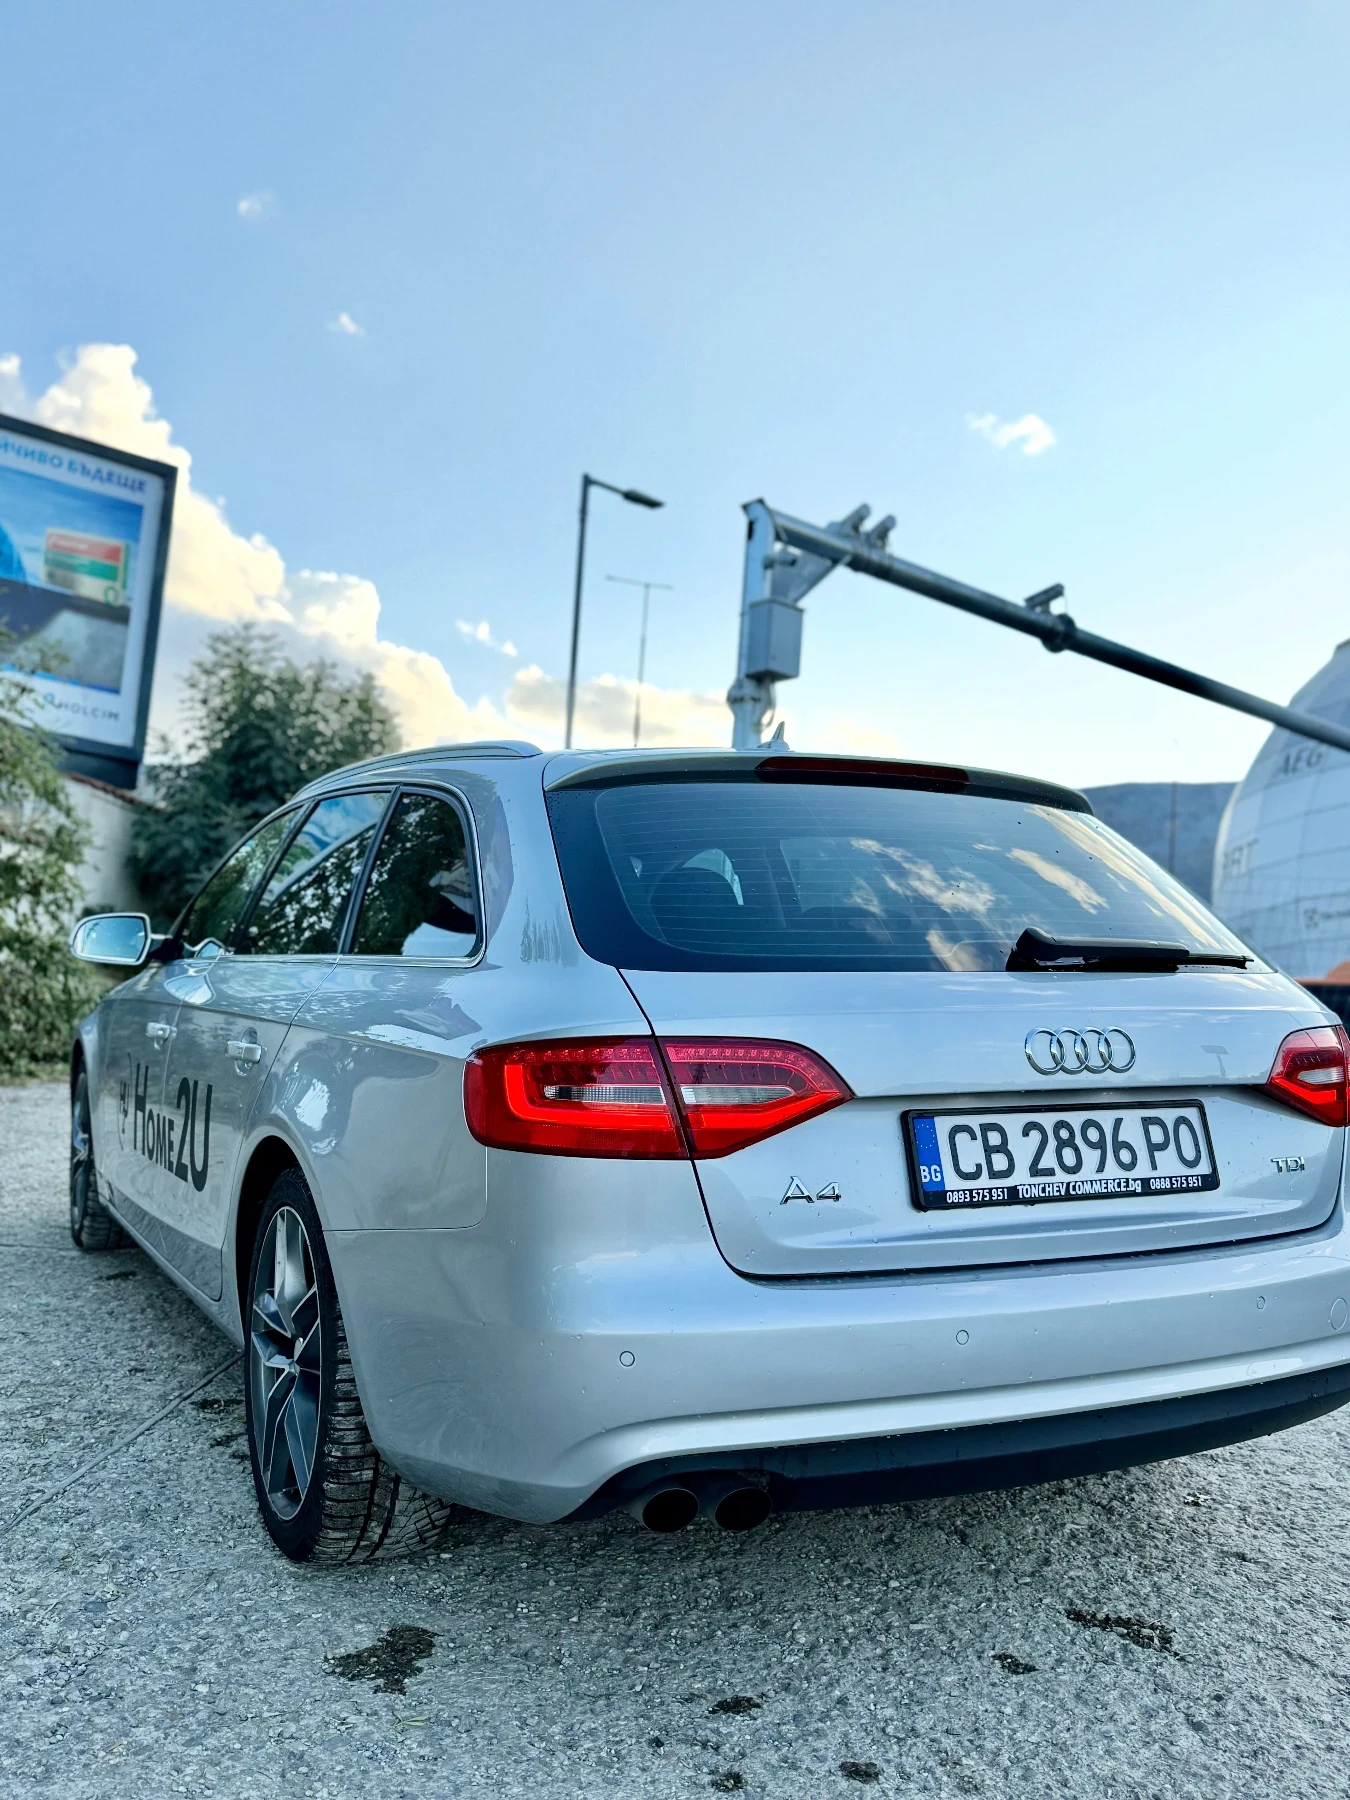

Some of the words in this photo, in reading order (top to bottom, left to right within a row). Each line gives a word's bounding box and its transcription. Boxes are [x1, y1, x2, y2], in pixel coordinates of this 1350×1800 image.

[67, 458, 148, 493] БЪДЕЩЕ
[948, 1122, 1016, 1181] CB
[1021, 1118, 1138, 1178] 2896
[1140, 1115, 1202, 1171] PO
[919, 1165, 942, 1183] BG
[1271, 1156, 1305, 1173] TDI
[780, 1176, 841, 1205] A4
[946, 1190, 970, 1203] 0893
[972, 1189, 990, 1202] 575
[991, 1188, 1008, 1200] 951
[1016, 1182, 1067, 1199] TONCHEV
[1069, 1178, 1142, 1195] COMMERCE.bg
[1150, 1177, 1171, 1190] 0888
[1172, 1176, 1187, 1188] 575
[1188, 1175, 1202, 1187] 951
